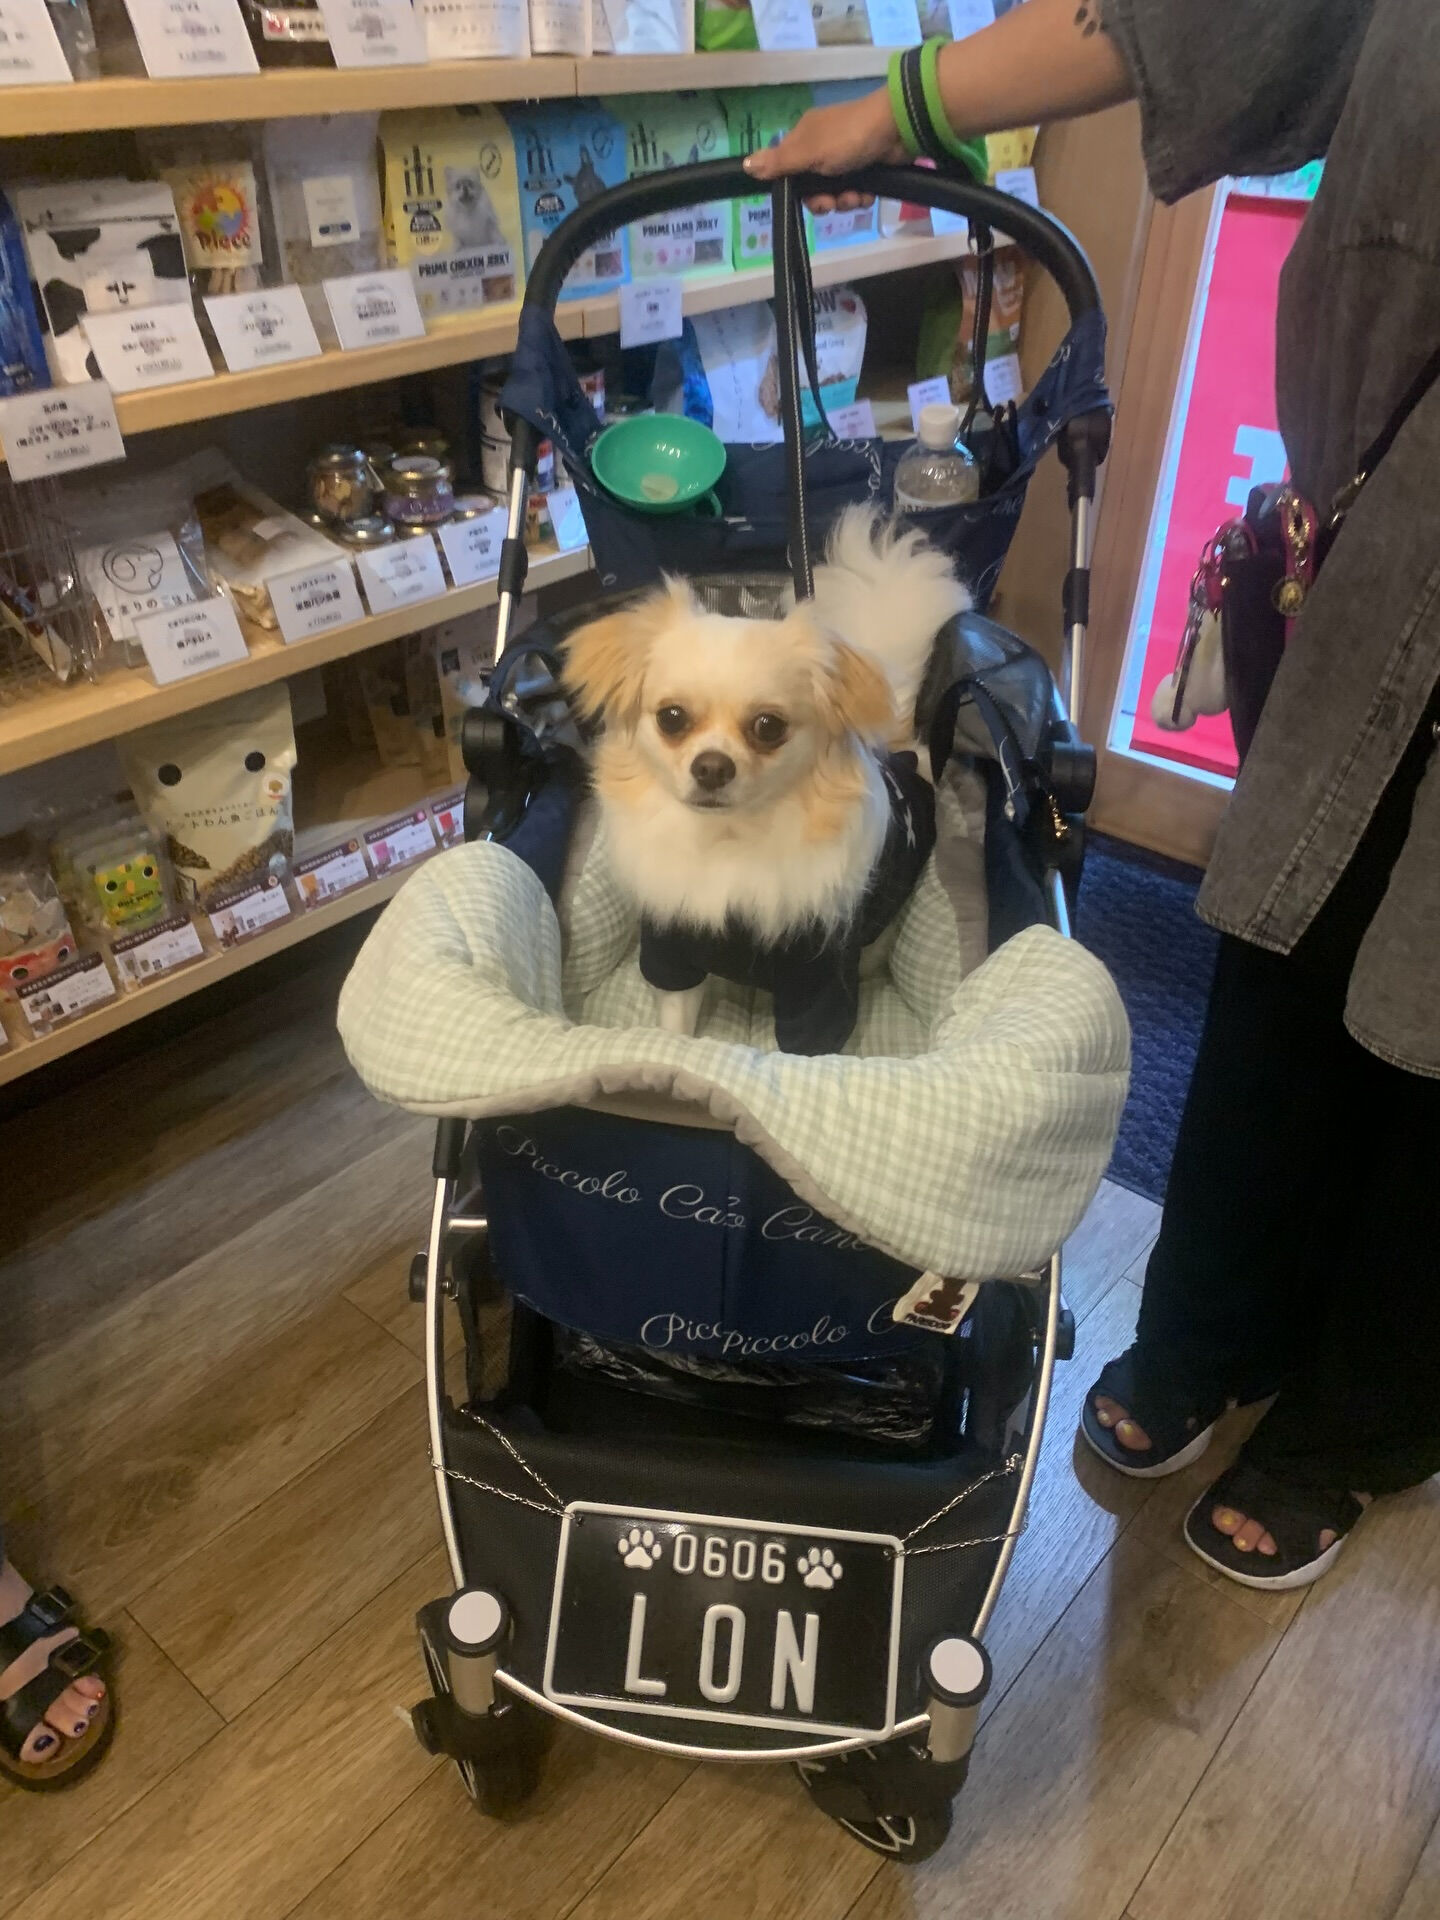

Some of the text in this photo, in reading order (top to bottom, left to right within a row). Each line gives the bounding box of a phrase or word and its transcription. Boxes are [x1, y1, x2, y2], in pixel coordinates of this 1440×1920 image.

[418, 261, 449, 278] PRIME
[449, 256, 485, 274] CHICKEN
[496, 1125, 642, 1204] Piccolo
[720, 1314, 851, 1355] Piccolo
[672, 1532, 787, 1584] 0606
[624, 1591, 820, 1714] LON
